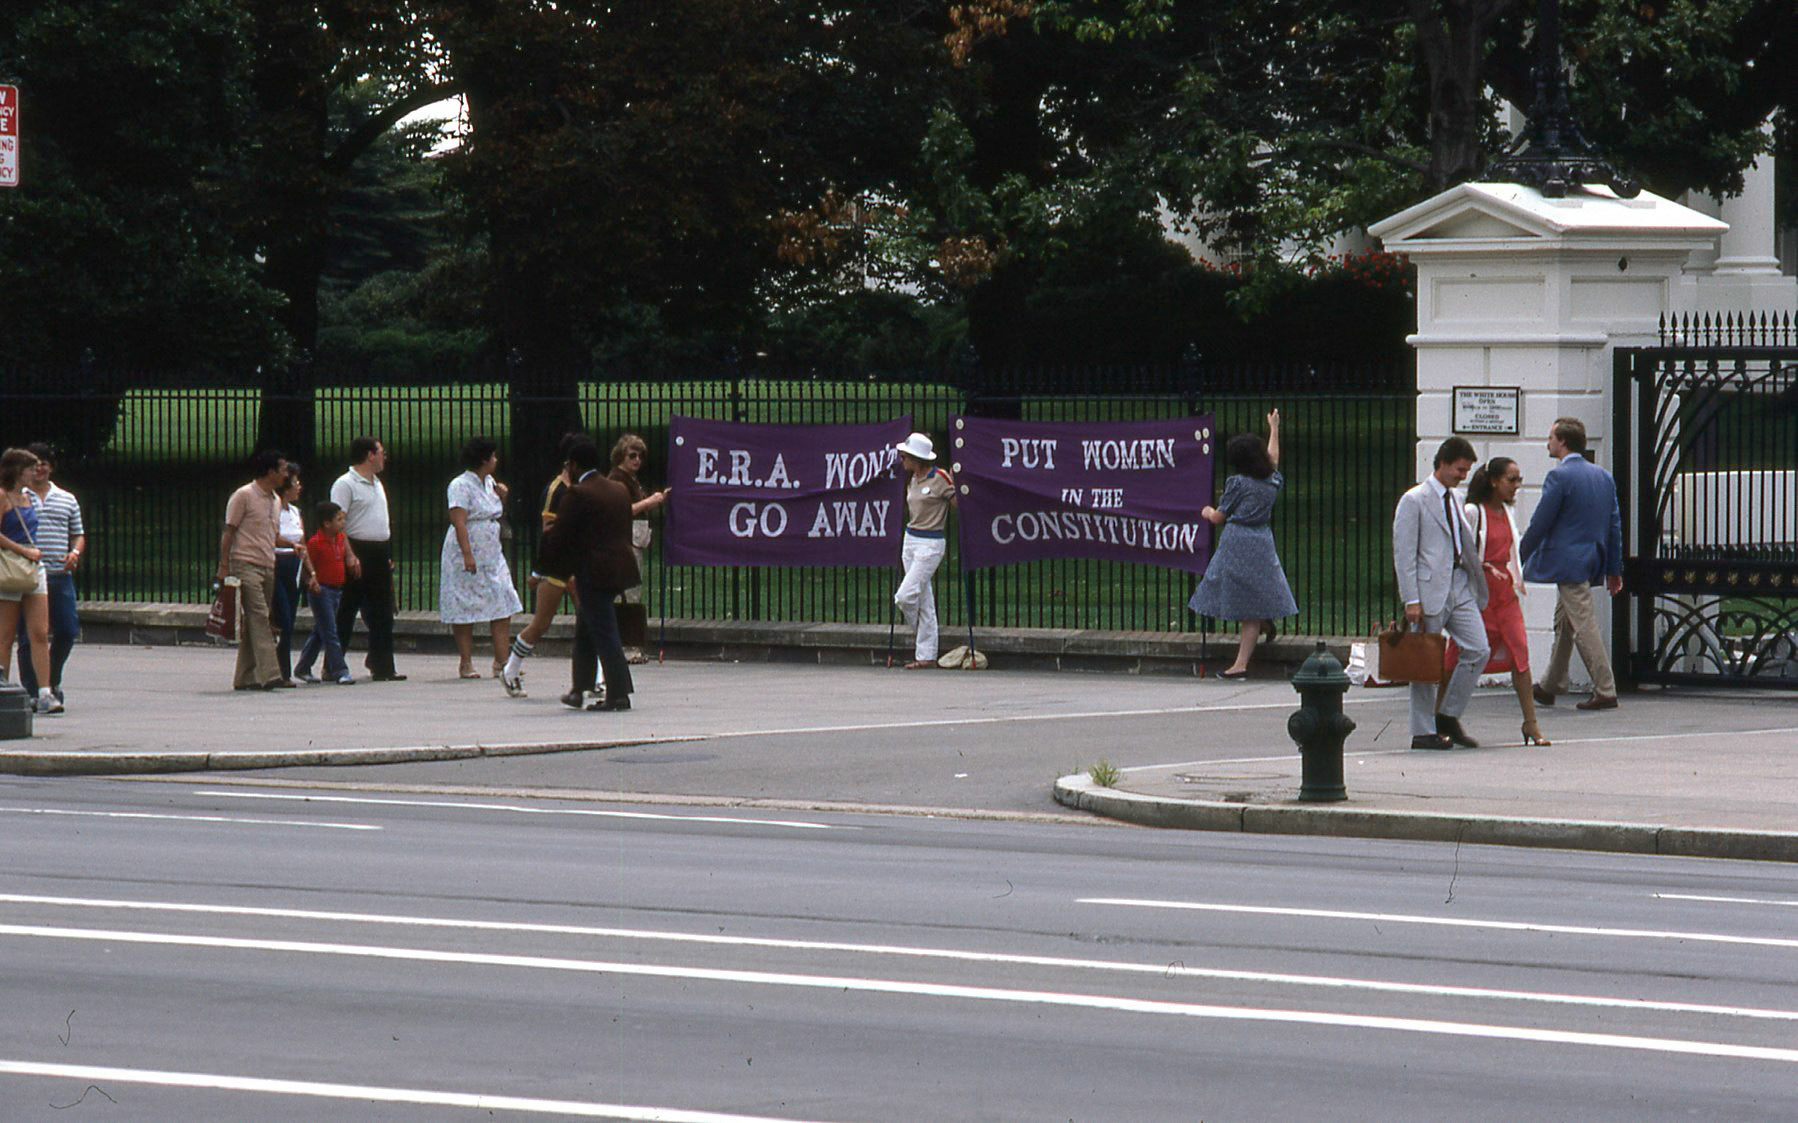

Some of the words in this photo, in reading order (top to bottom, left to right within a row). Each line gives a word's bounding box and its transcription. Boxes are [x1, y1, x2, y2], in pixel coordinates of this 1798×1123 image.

[694, 448, 800, 489] E.R.A.
[825, 443, 898, 489] WON'T
[1001, 438, 1057, 470] PUT
[1081, 438, 1176, 471] WOMEN
[1061, 488, 1083, 506] IN
[1091, 488, 1123, 508] THE
[729, 502, 788, 537] GO
[807, 500, 890, 537] AWAY
[991, 511, 1199, 553] CONSTITUTION
